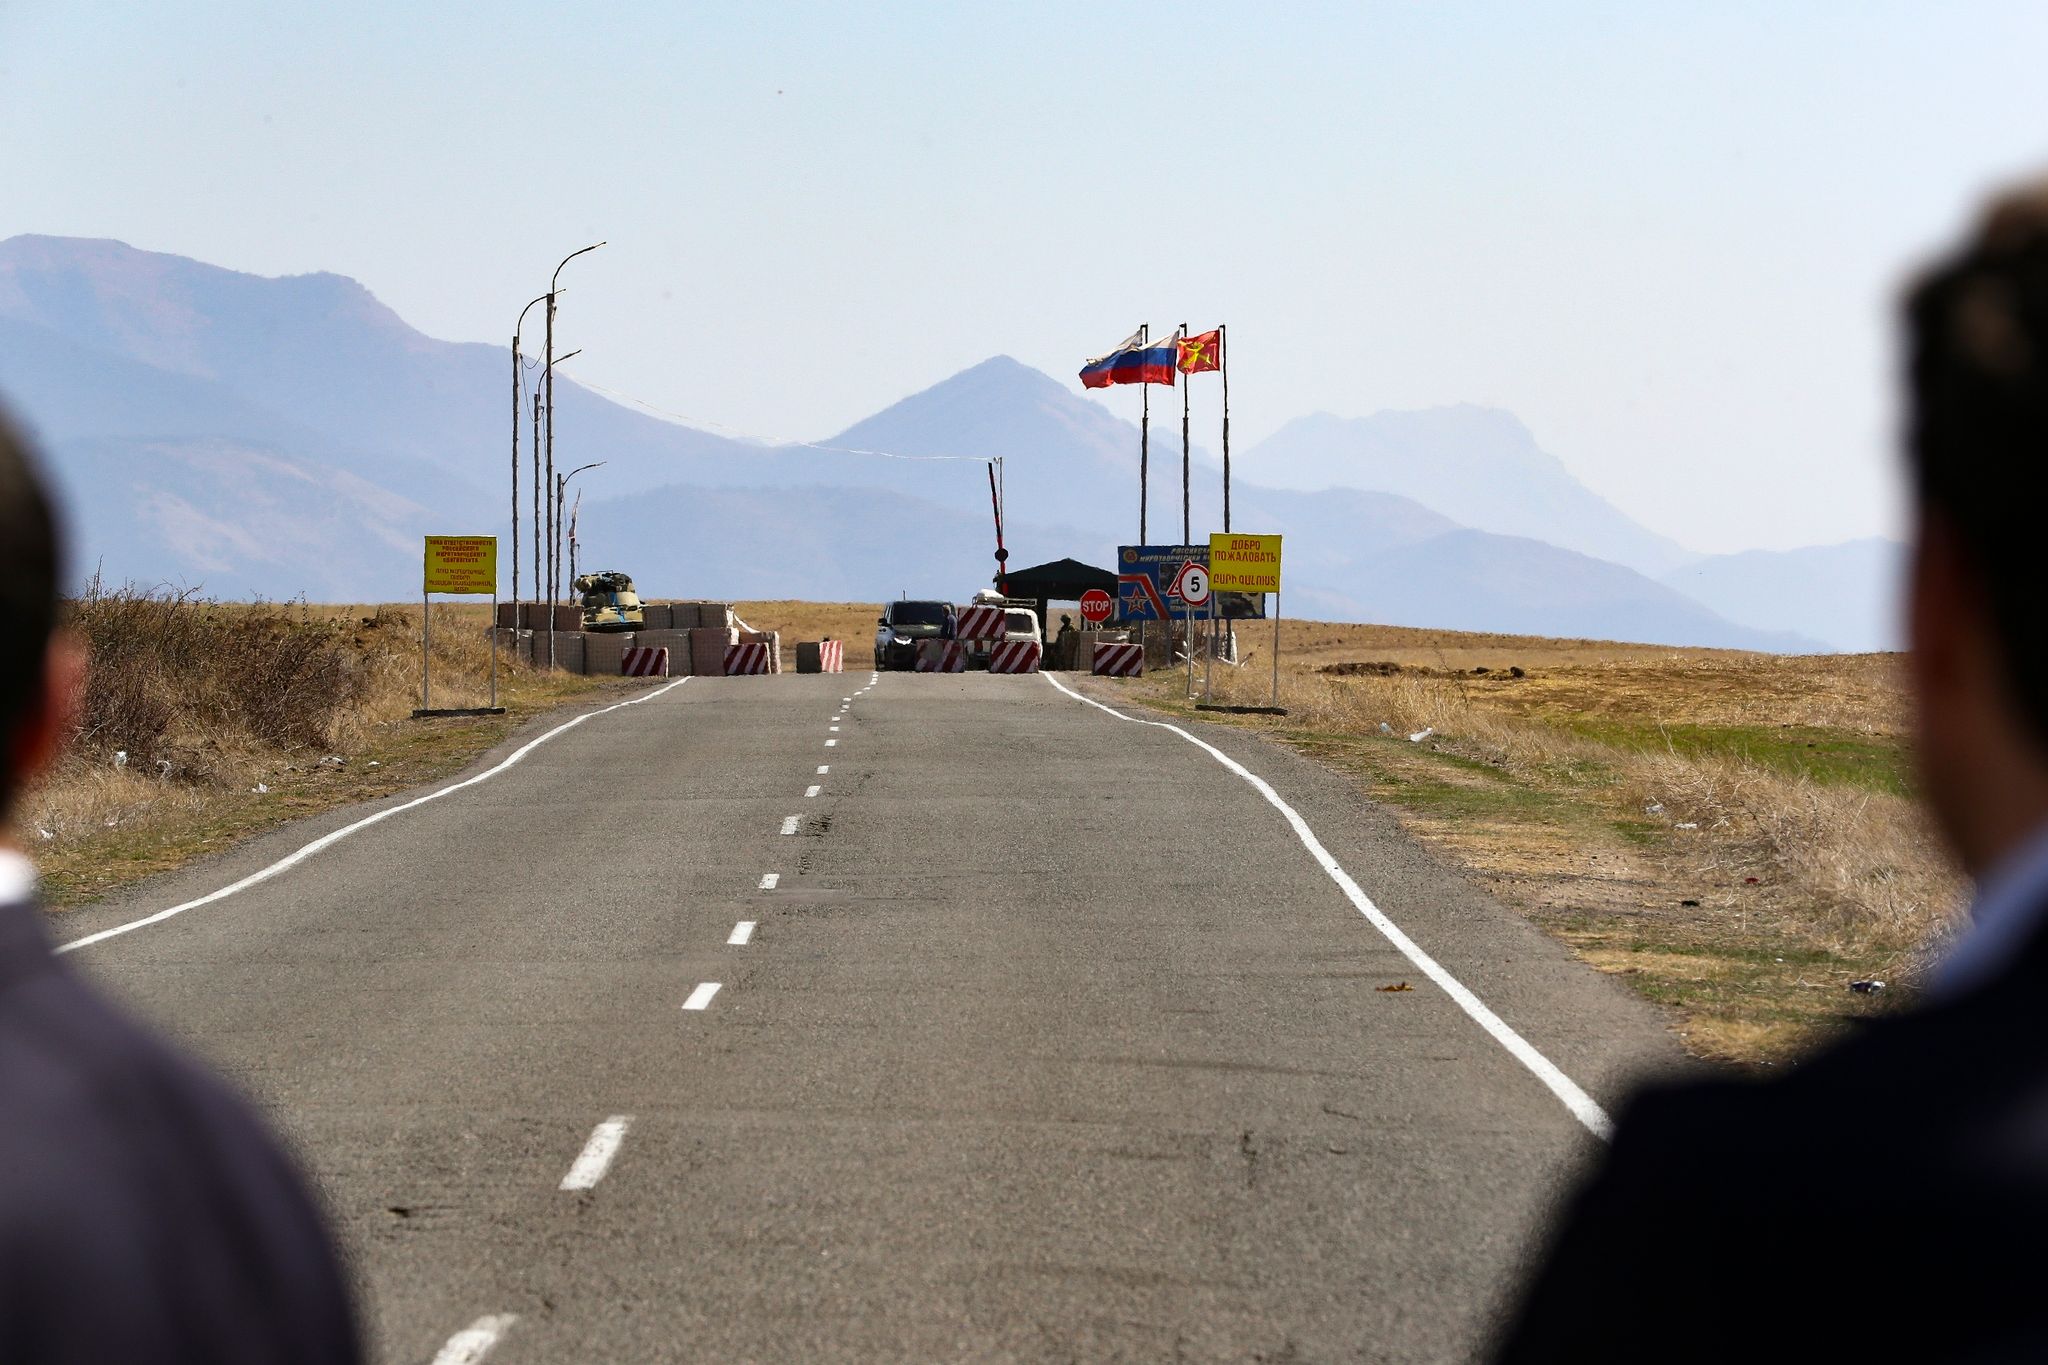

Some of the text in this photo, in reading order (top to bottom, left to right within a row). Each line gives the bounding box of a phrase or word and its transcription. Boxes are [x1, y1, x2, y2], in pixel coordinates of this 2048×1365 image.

[1231, 539, 1261, 551] ДОБРО
[1214, 550, 1277, 563] ПОЖАЛОВАТЬ
[1190, 576, 1201, 593] 5
[1082, 600, 1109, 612] STOP
